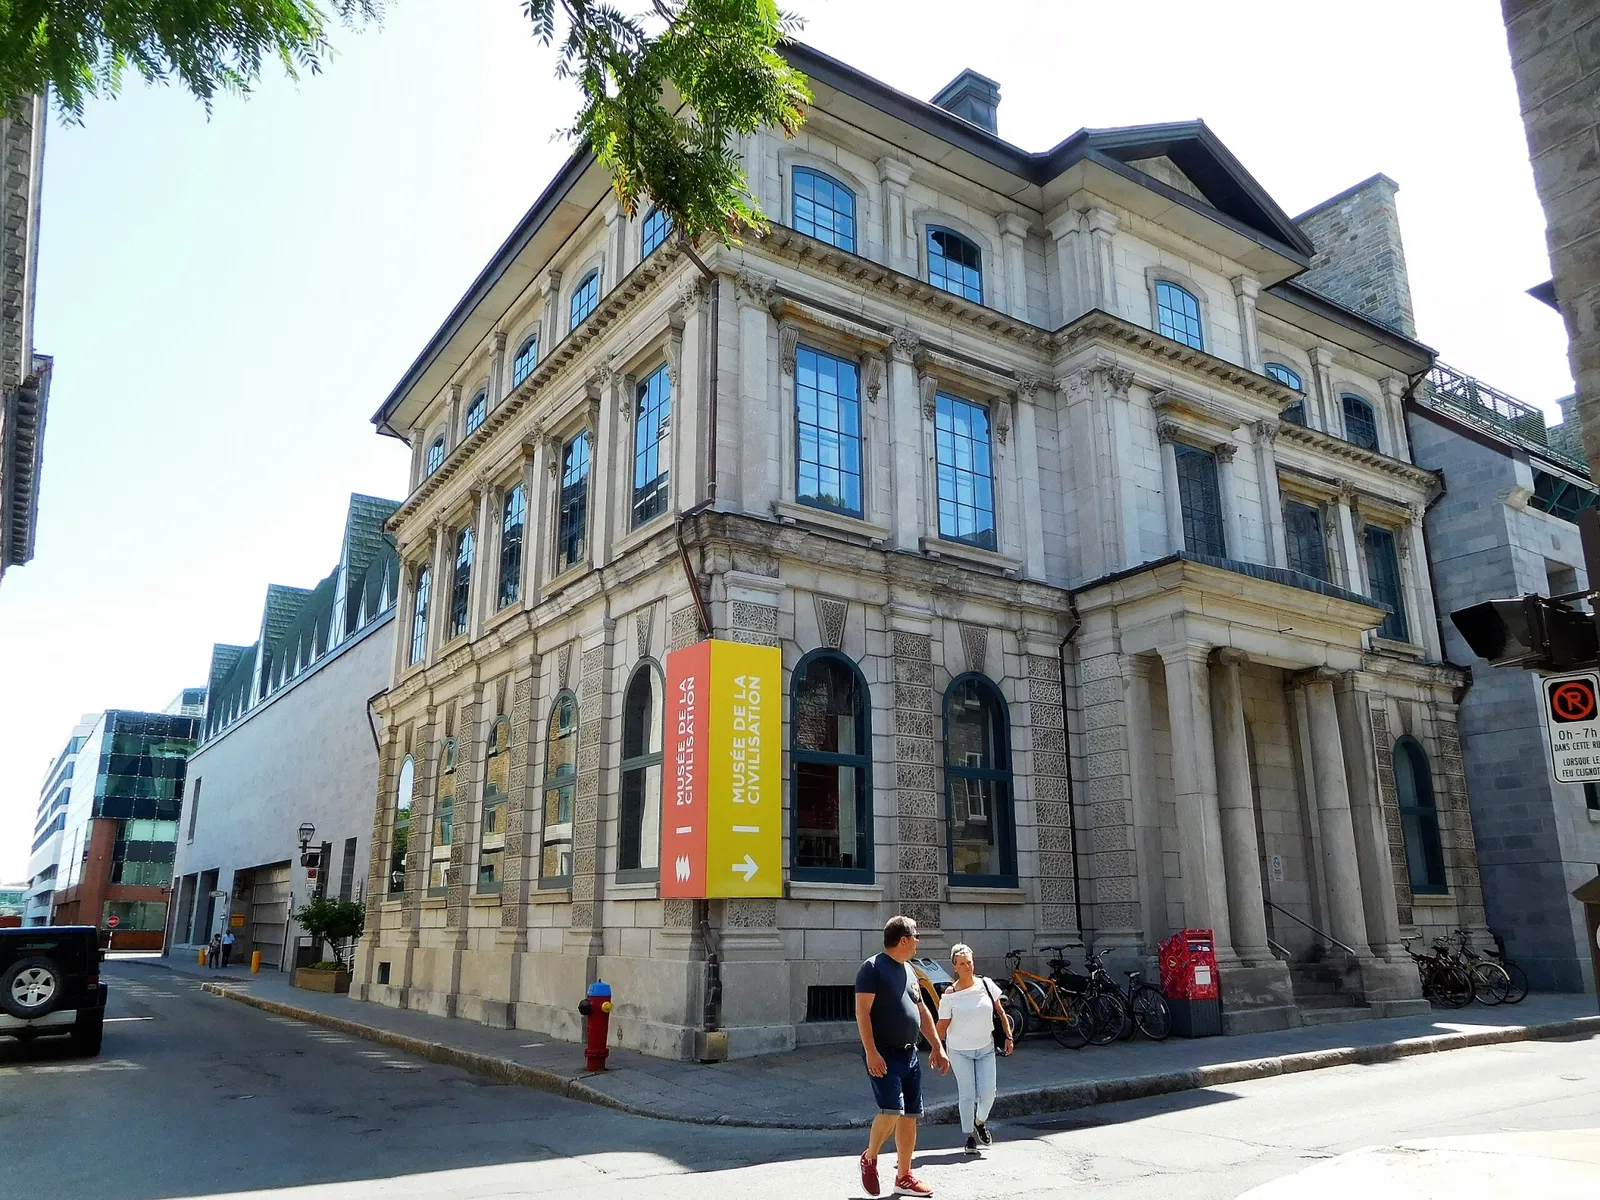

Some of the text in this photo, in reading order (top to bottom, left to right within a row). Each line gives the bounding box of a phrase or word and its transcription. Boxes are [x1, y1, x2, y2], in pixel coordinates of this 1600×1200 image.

[676, 679, 686, 805] MUSÉE DE LA
[684, 676, 695, 805] CIVILISATION
[730, 675, 746, 803] MUSÉE DE LA
[747, 676, 761, 804] CIVILISATION
[1554, 743, 1571, 752] DANS
[1572, 741, 1590, 751] CETTE
[1562, 755, 1600, 767] LORSQUE LE
[1562, 769, 1574, 778] FEU
